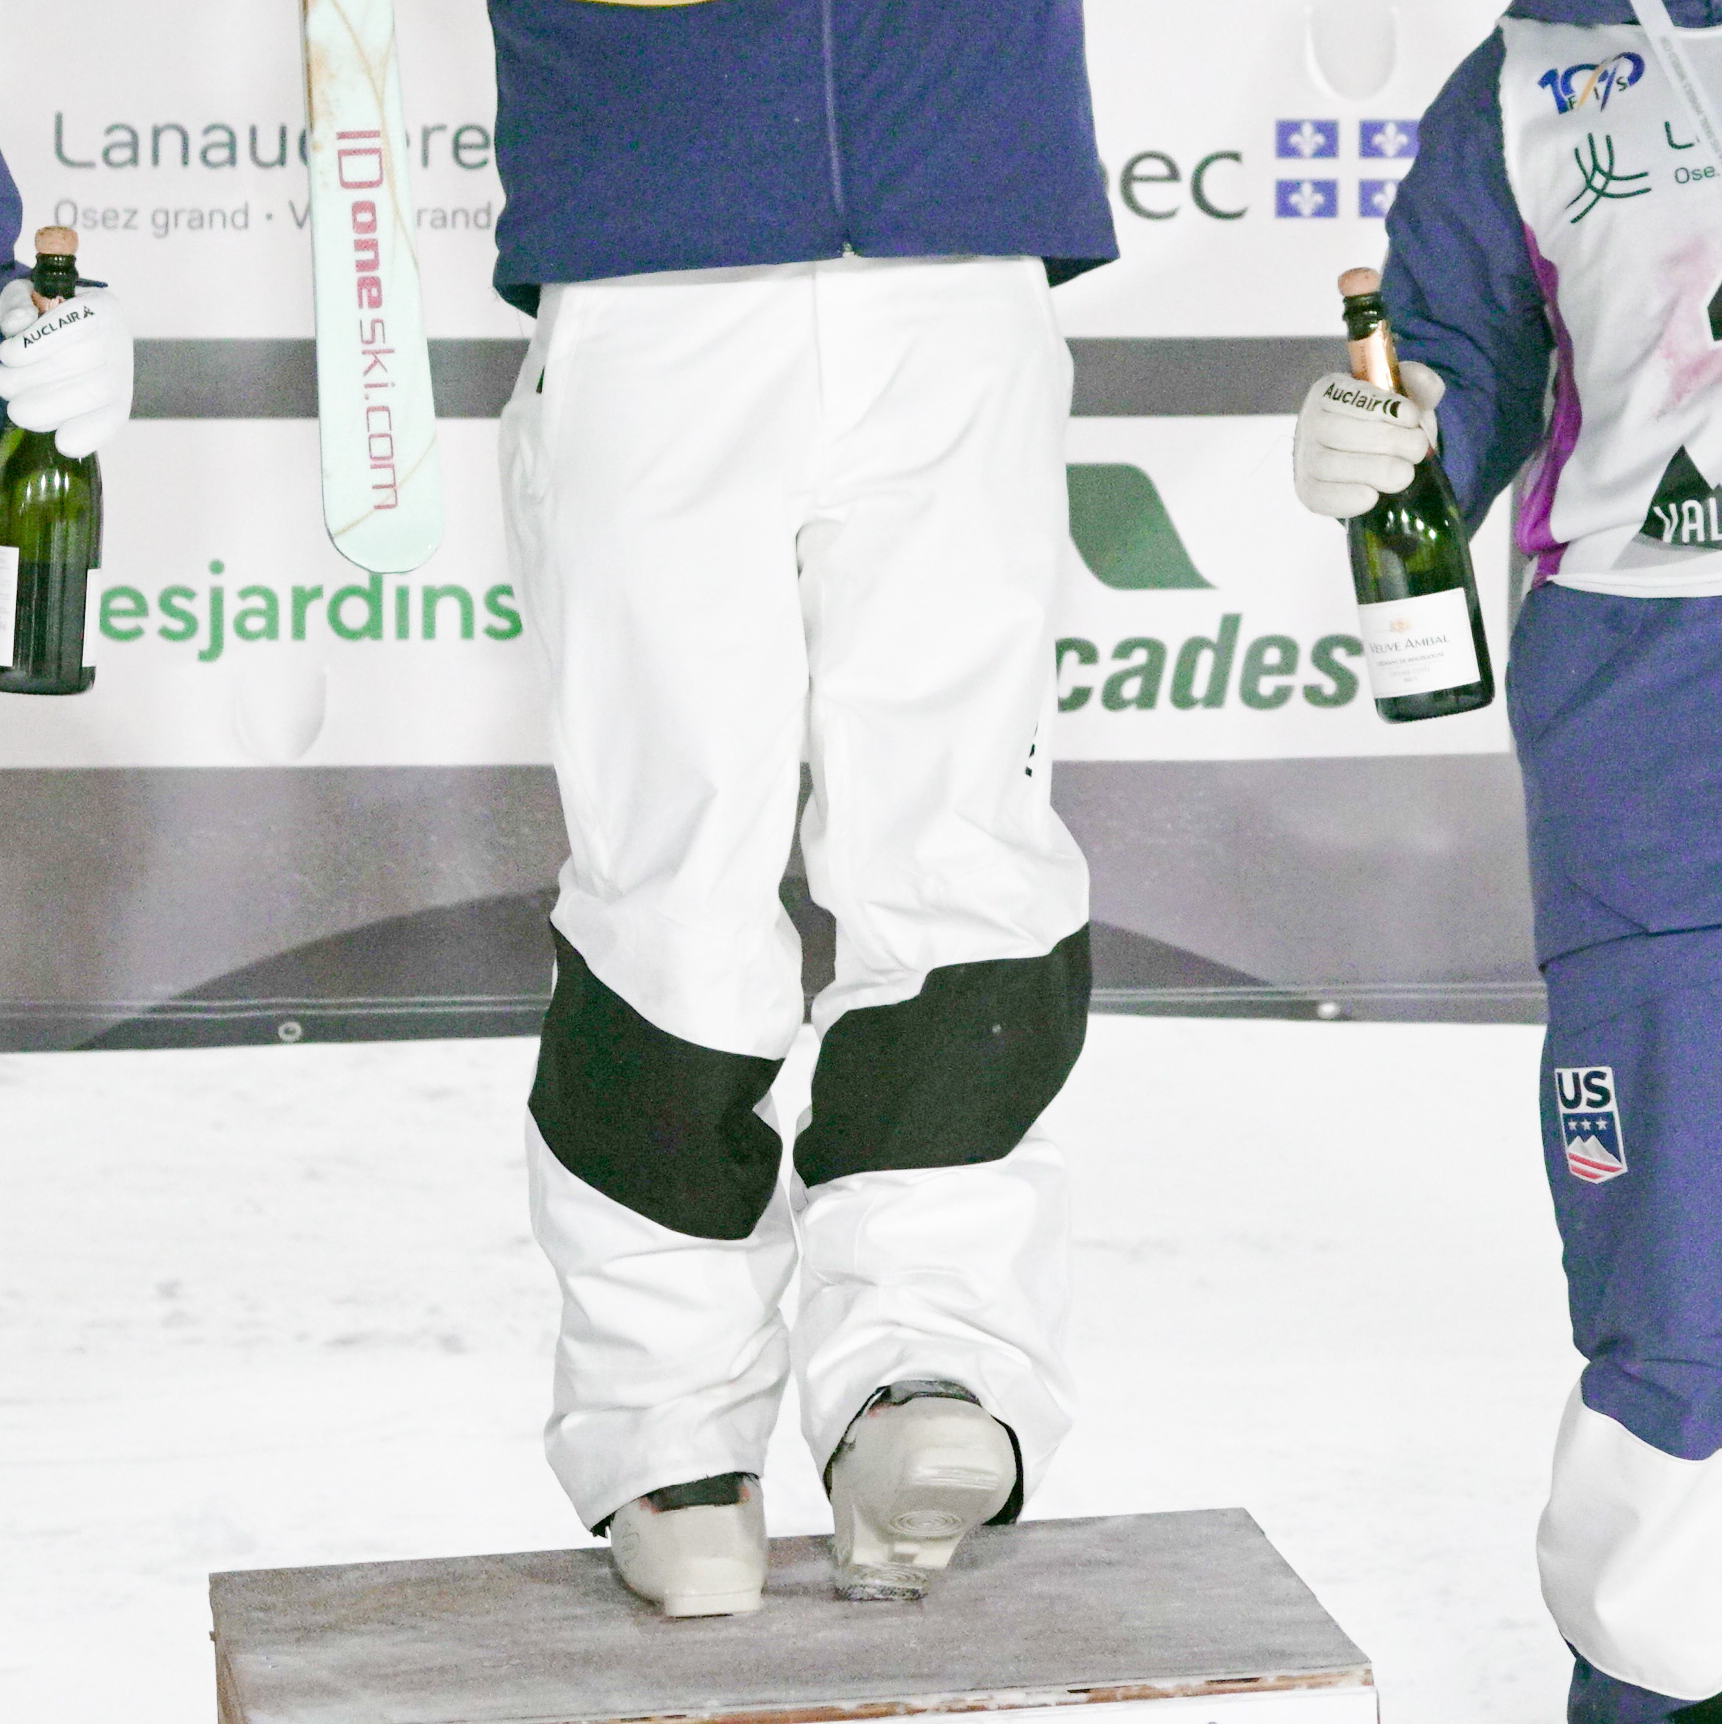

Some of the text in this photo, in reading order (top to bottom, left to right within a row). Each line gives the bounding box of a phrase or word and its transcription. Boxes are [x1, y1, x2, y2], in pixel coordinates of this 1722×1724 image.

[55, 199, 493, 239] Osez grand rand
[22, 309, 82, 349] AUCLAIR
[1323, 381, 1382, 413] Auclair
[98, 560, 525, 664] esjardins
[1369, 641, 1401, 654] VEUVE
[1557, 1070, 1611, 1110] US
